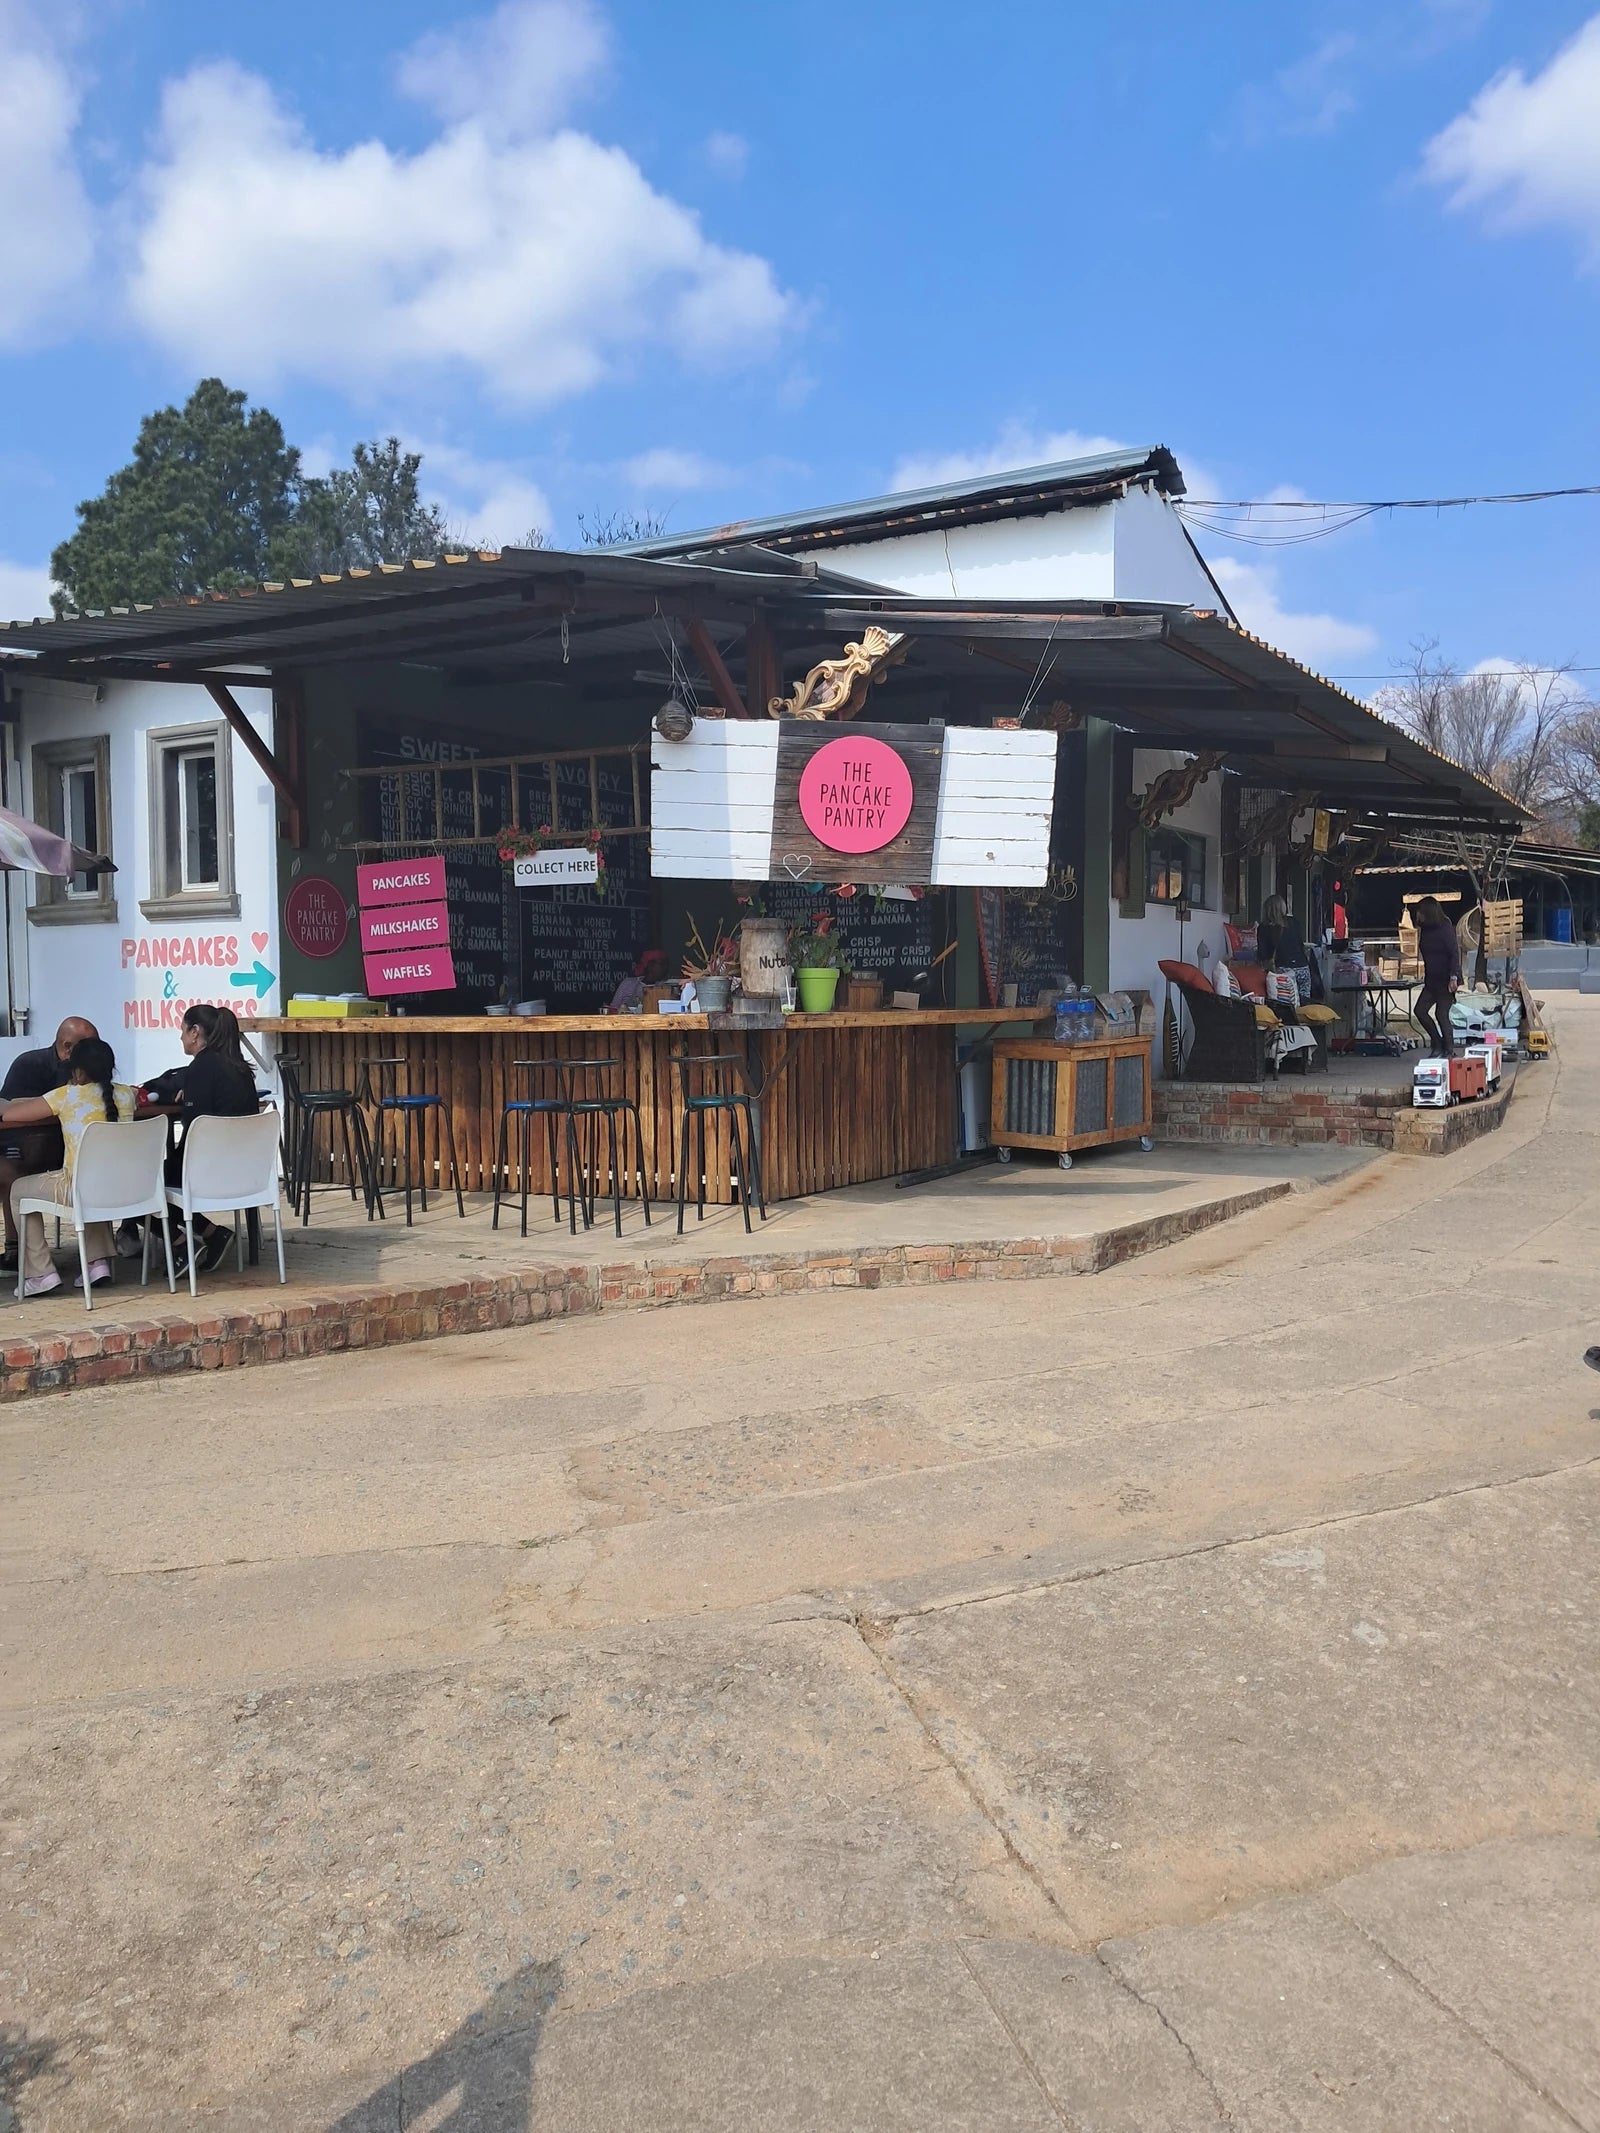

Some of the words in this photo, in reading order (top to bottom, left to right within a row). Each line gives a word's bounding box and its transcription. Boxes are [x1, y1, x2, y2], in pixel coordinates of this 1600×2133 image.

[399, 735, 480, 763] SWEET
[843, 761, 872, 783] THE
[820, 783, 892, 807] PANCAKE
[824, 806, 886, 829] PANTRY
[516, 862, 566, 876] COLLECT
[568, 860, 597, 873] HERE
[373, 873, 431, 891] PANCAKES
[308, 893, 327, 910] THE
[531, 902, 567, 915] HONEY
[297, 909, 339, 926] PANCAKE
[838, 905, 861, 916] MILK
[370, 917, 439, 937] MILKSHAKES
[532, 914, 573, 927] BANANA
[838, 916, 861, 928] MILK
[870, 913, 912, 926] BANANA
[301, 926, 336, 943] PANTRY
[470, 926, 497, 940] FUDGE
[532, 926, 573, 937] BANANA
[584, 940, 609, 951] NUTS
[850, 937, 881, 948] CRISP
[121, 935, 239, 969] PANCAKES
[534, 949, 570, 961] PEANUT
[901, 945, 931, 957] CRISP
[553, 960, 580, 972] HONEY
[594, 961, 611, 972] YOG
[862, 957, 896, 969] SCOOP
[382, 963, 433, 982] WAFFLES
[532, 970, 563, 983] APPLE
[565, 972, 611, 984] CINNAMON
[163, 970, 181, 999] &
[466, 973, 496, 988] NUTS
[554, 982, 586, 994] HONEY
[591, 982, 616, 994] NUTS
